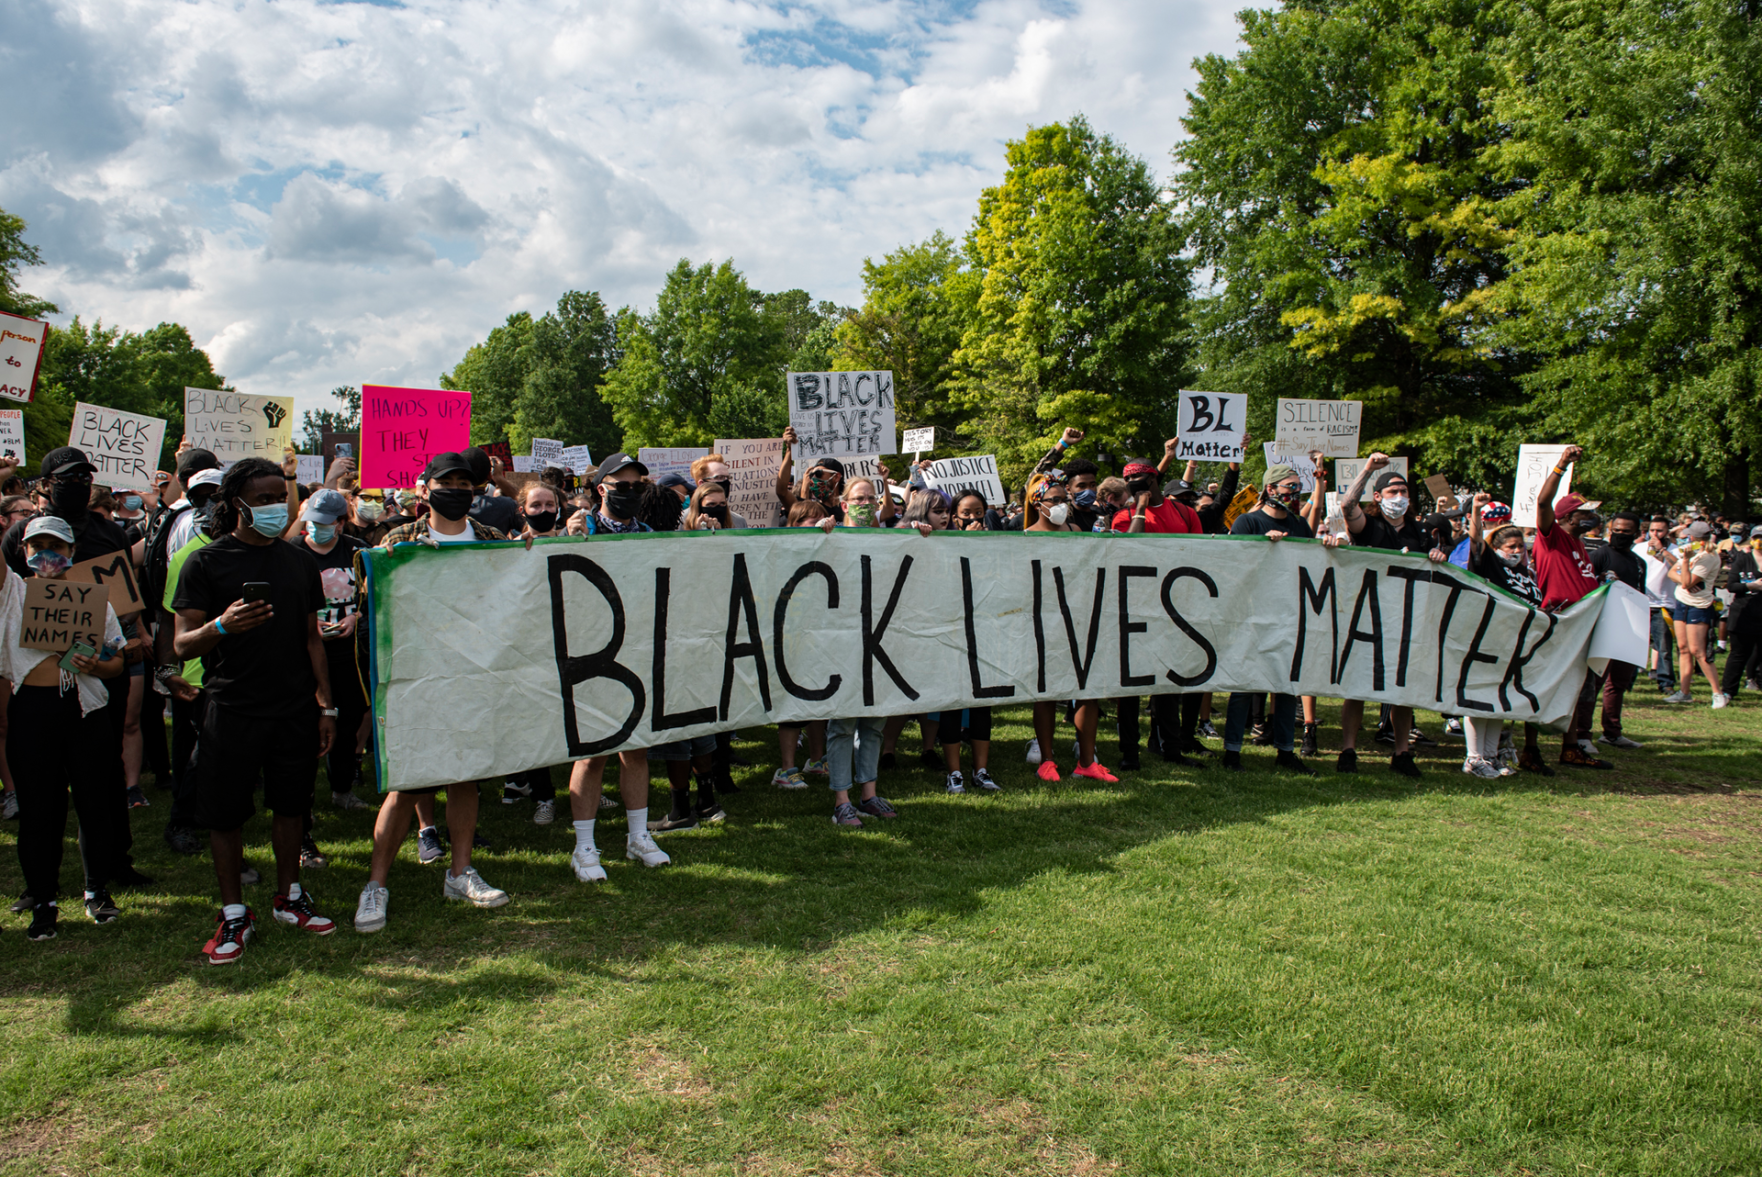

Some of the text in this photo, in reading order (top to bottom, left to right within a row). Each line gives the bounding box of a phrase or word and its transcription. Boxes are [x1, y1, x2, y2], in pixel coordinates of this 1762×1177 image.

[5, 356, 21, 368] to
[188, 390, 258, 415] BLACK
[794, 372, 895, 412] BLACK
[371, 398, 471, 426] HANDS UP?
[1284, 402, 1353, 423] SILENCE
[83, 411, 151, 442] BLACK
[815, 409, 883, 437] LIVES
[905, 428, 932, 437] HISTORY
[79, 430, 144, 455] LIVES
[376, 428, 429, 452] THEY
[534, 445, 561, 454] GEORGE
[720, 441, 783, 455] IF YOU ARE
[798, 433, 881, 458] MATTER
[1179, 441, 1244, 458] Matter!
[725, 455, 774, 469] SILENT IN
[924, 457, 993, 480] NO JUSTICE
[741, 492, 769, 502] HAVE
[1520, 484, 1537, 513] Fuera
[748, 511, 768, 520] THE
[44, 584, 92, 604] SAY
[29, 607, 92, 627] THEIR
[24, 627, 98, 648] NAMES
[547, 553, 1558, 757] BLACK LIVES MATTER
